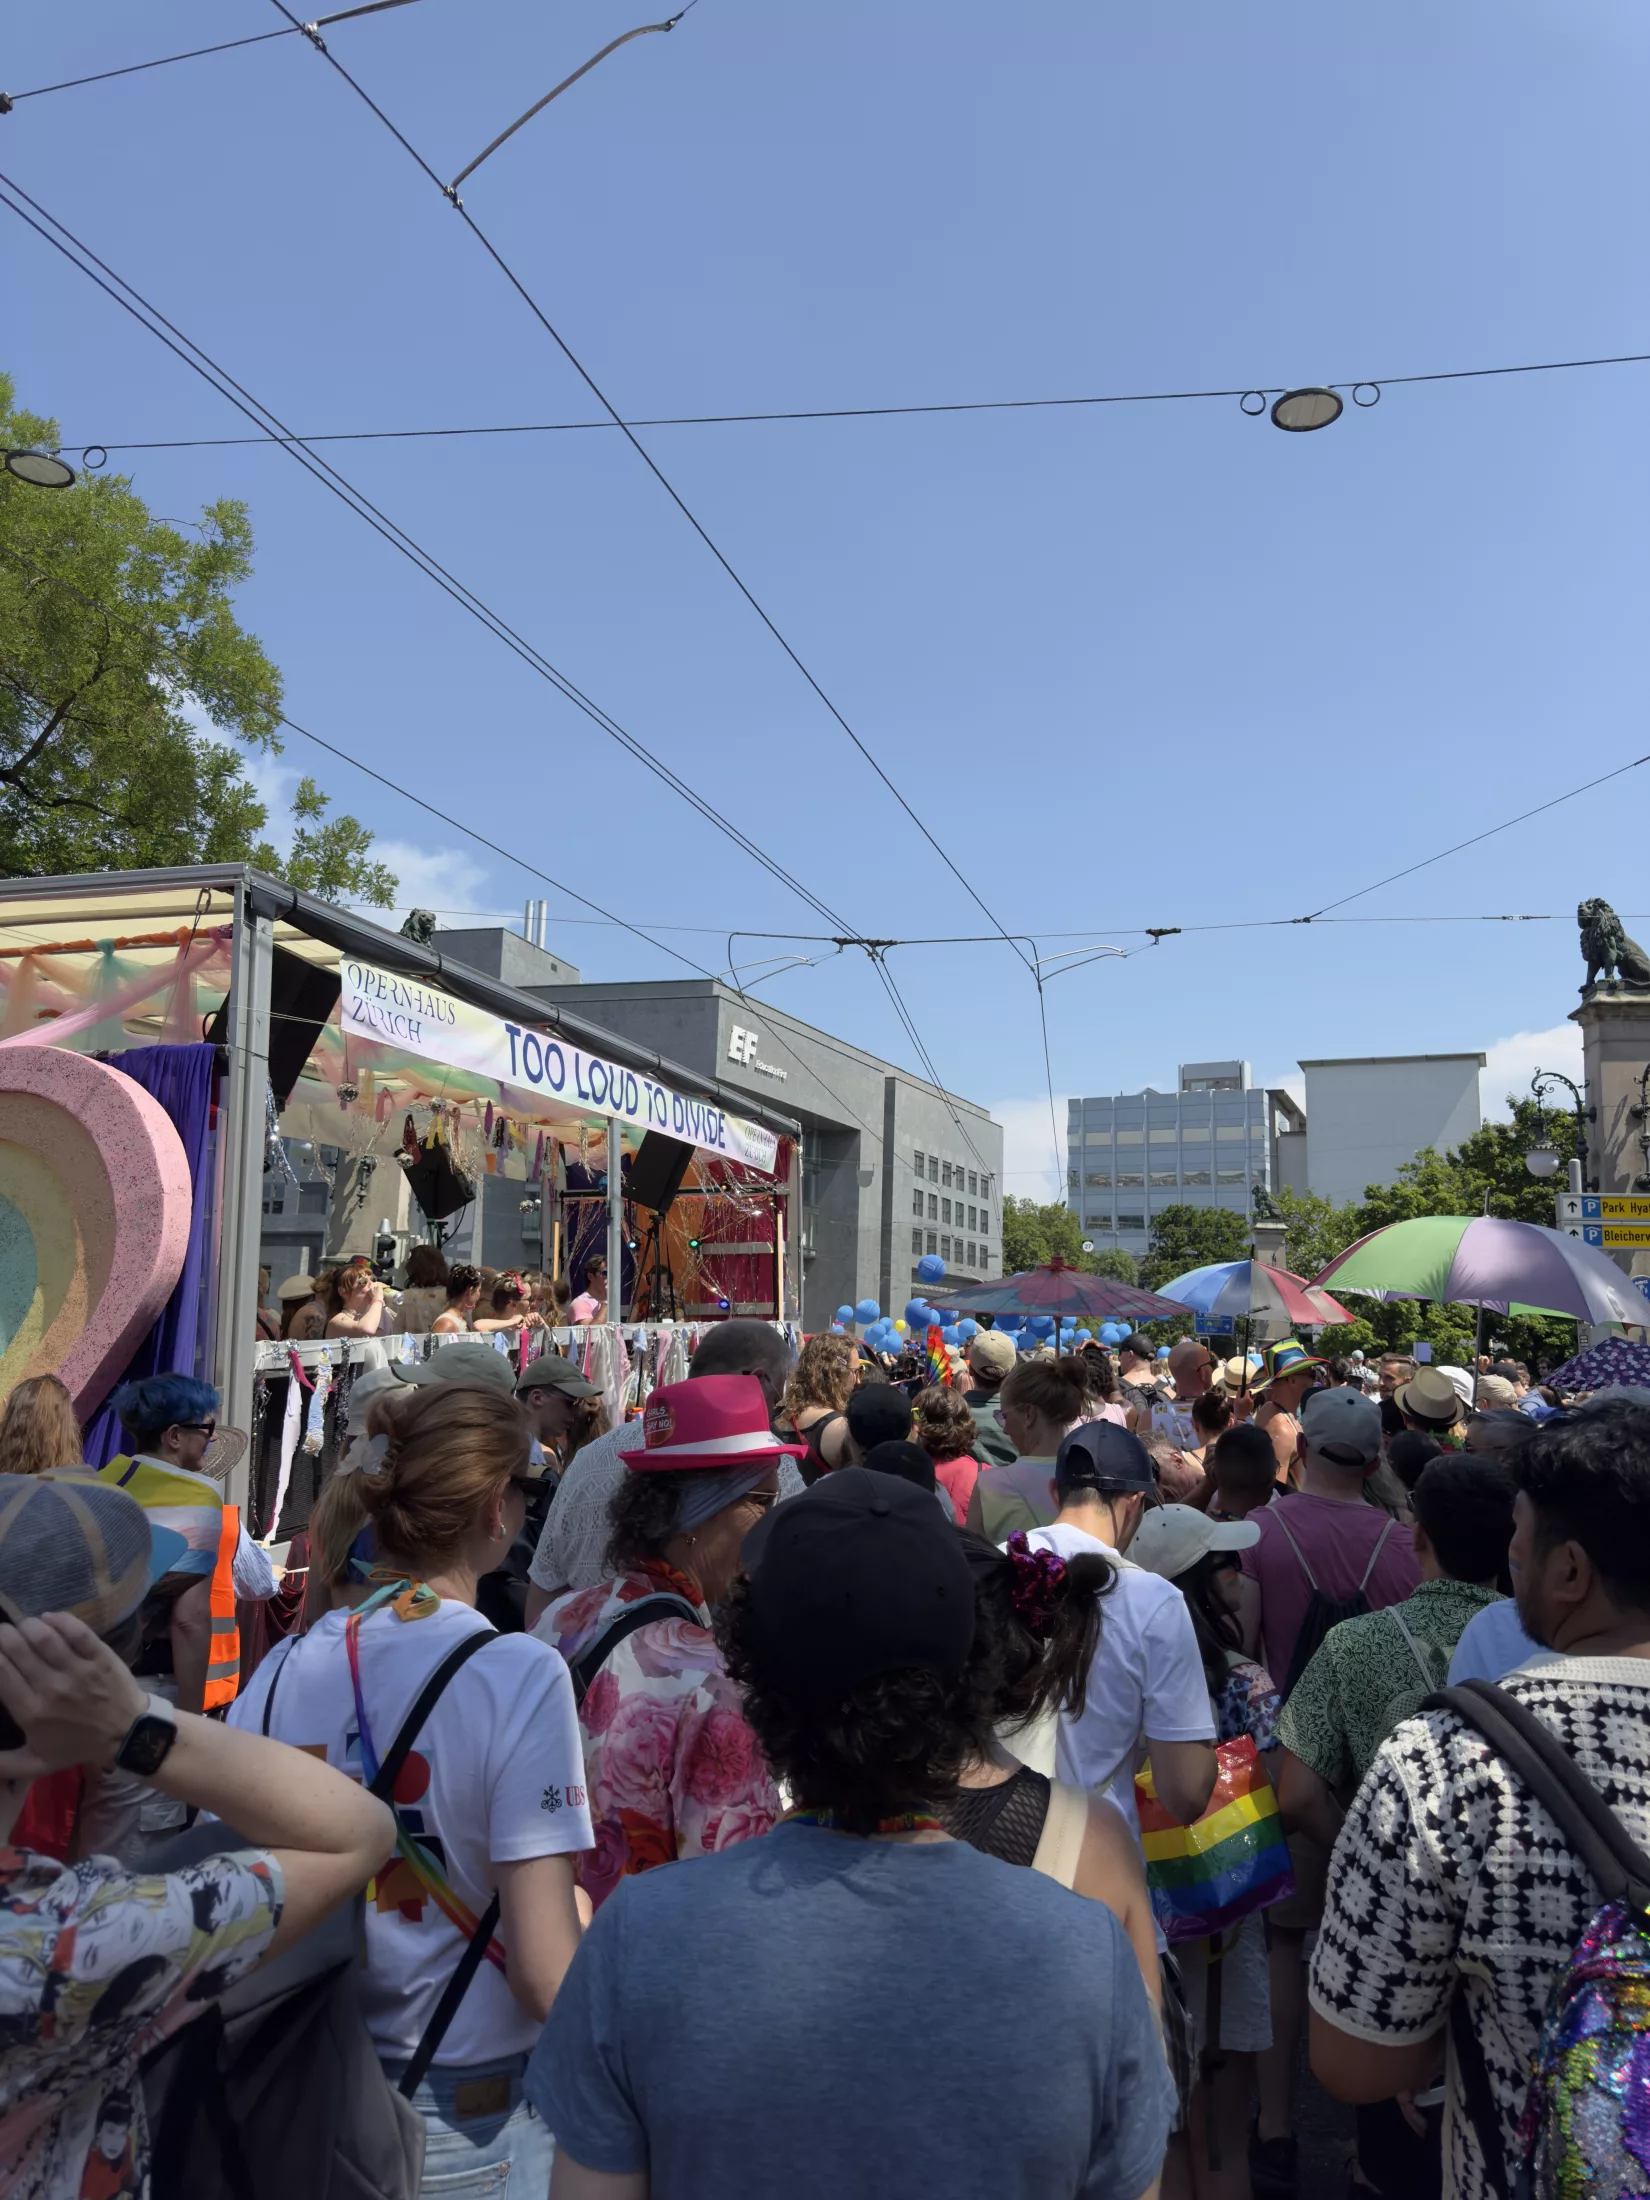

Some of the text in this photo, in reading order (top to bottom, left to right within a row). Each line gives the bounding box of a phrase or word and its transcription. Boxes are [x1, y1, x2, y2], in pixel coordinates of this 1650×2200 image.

[347, 963, 456, 1026] OPERNHAUS
[351, 995, 423, 1044] ZÜRICH
[728, 1024, 759, 1064] EF
[504, 1023, 726, 1149] TOO LOUD TO DIVIDE
[1602, 1201, 1625, 1213] Park
[646, 1406, 666, 1417] GIRLS
[646, 1418, 673, 1431] SAY NO!
[565, 1785, 586, 1807] UBS
